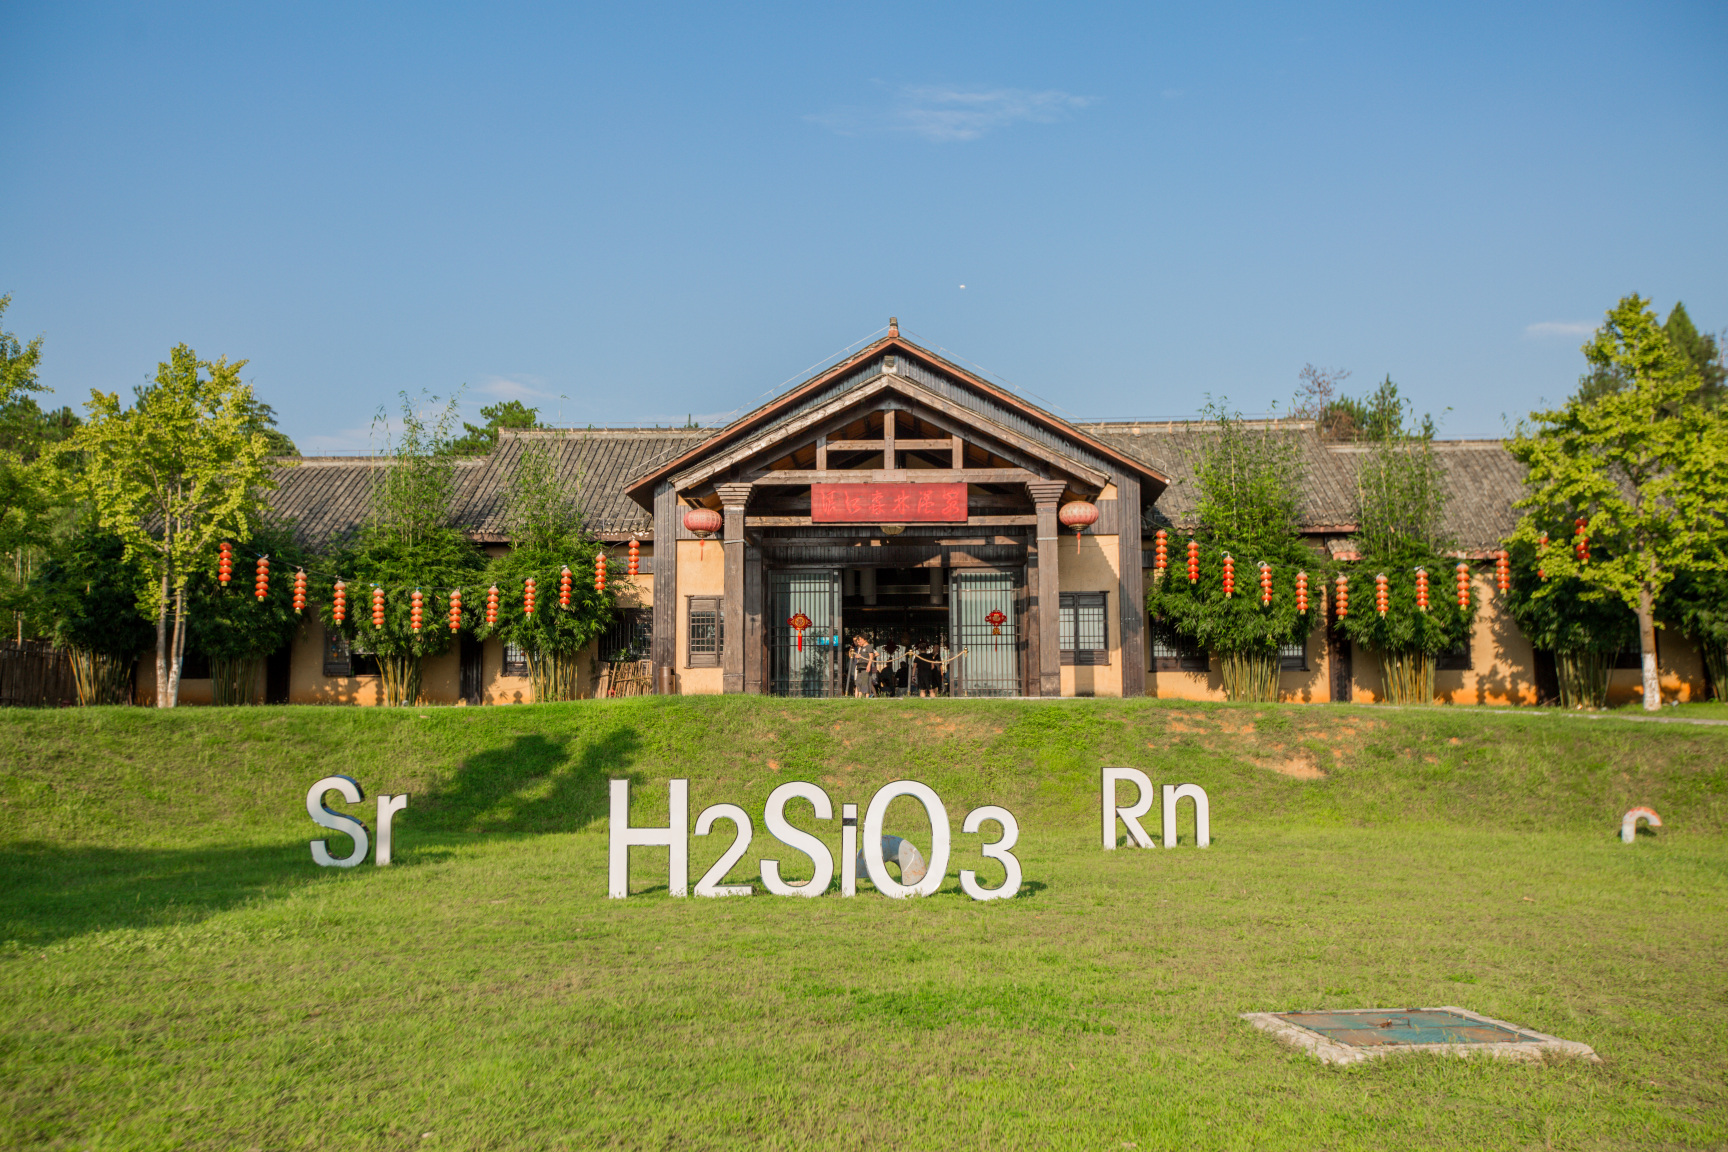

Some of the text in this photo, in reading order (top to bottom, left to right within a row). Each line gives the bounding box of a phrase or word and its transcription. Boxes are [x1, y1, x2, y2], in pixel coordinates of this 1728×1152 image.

[306, 775, 409, 867] Sr
[609, 778, 1022, 900] H2SiO3
[1101, 767, 1211, 850] Rn
